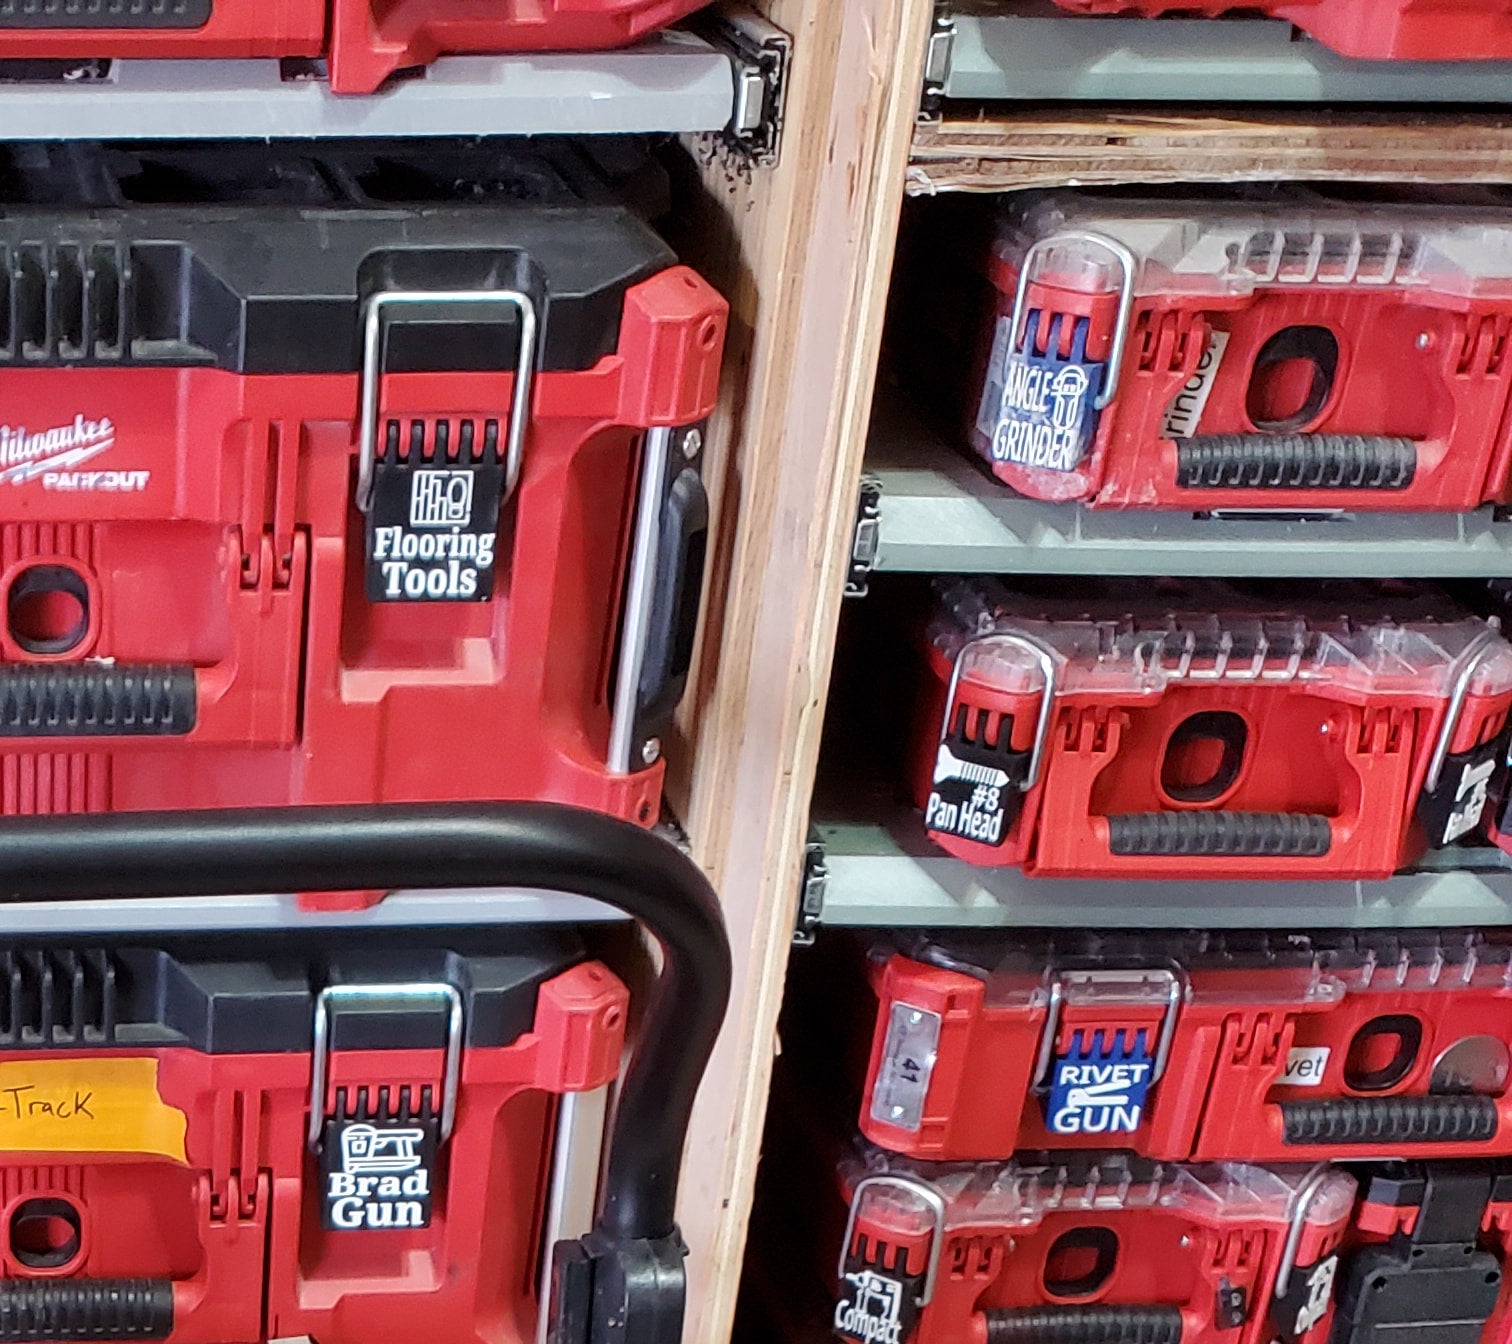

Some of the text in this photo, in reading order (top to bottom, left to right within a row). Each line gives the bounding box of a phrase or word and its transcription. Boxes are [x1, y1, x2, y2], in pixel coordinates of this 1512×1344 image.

[1001, 361, 1054, 413] ANGLE
[991, 418, 1074, 470] GRINDER
[373, 525, 496, 568] Flooring
[381, 559, 478, 598] Tools
[972, 783, 1001, 812] #8
[925, 792, 1005, 842] Pan Head
[1059, 1063, 1150, 1085] RIVET
[1053, 1105, 1141, 1134] GUN
[328, 1168, 430, 1197] Brad
[331, 1196, 425, 1228] Gun
